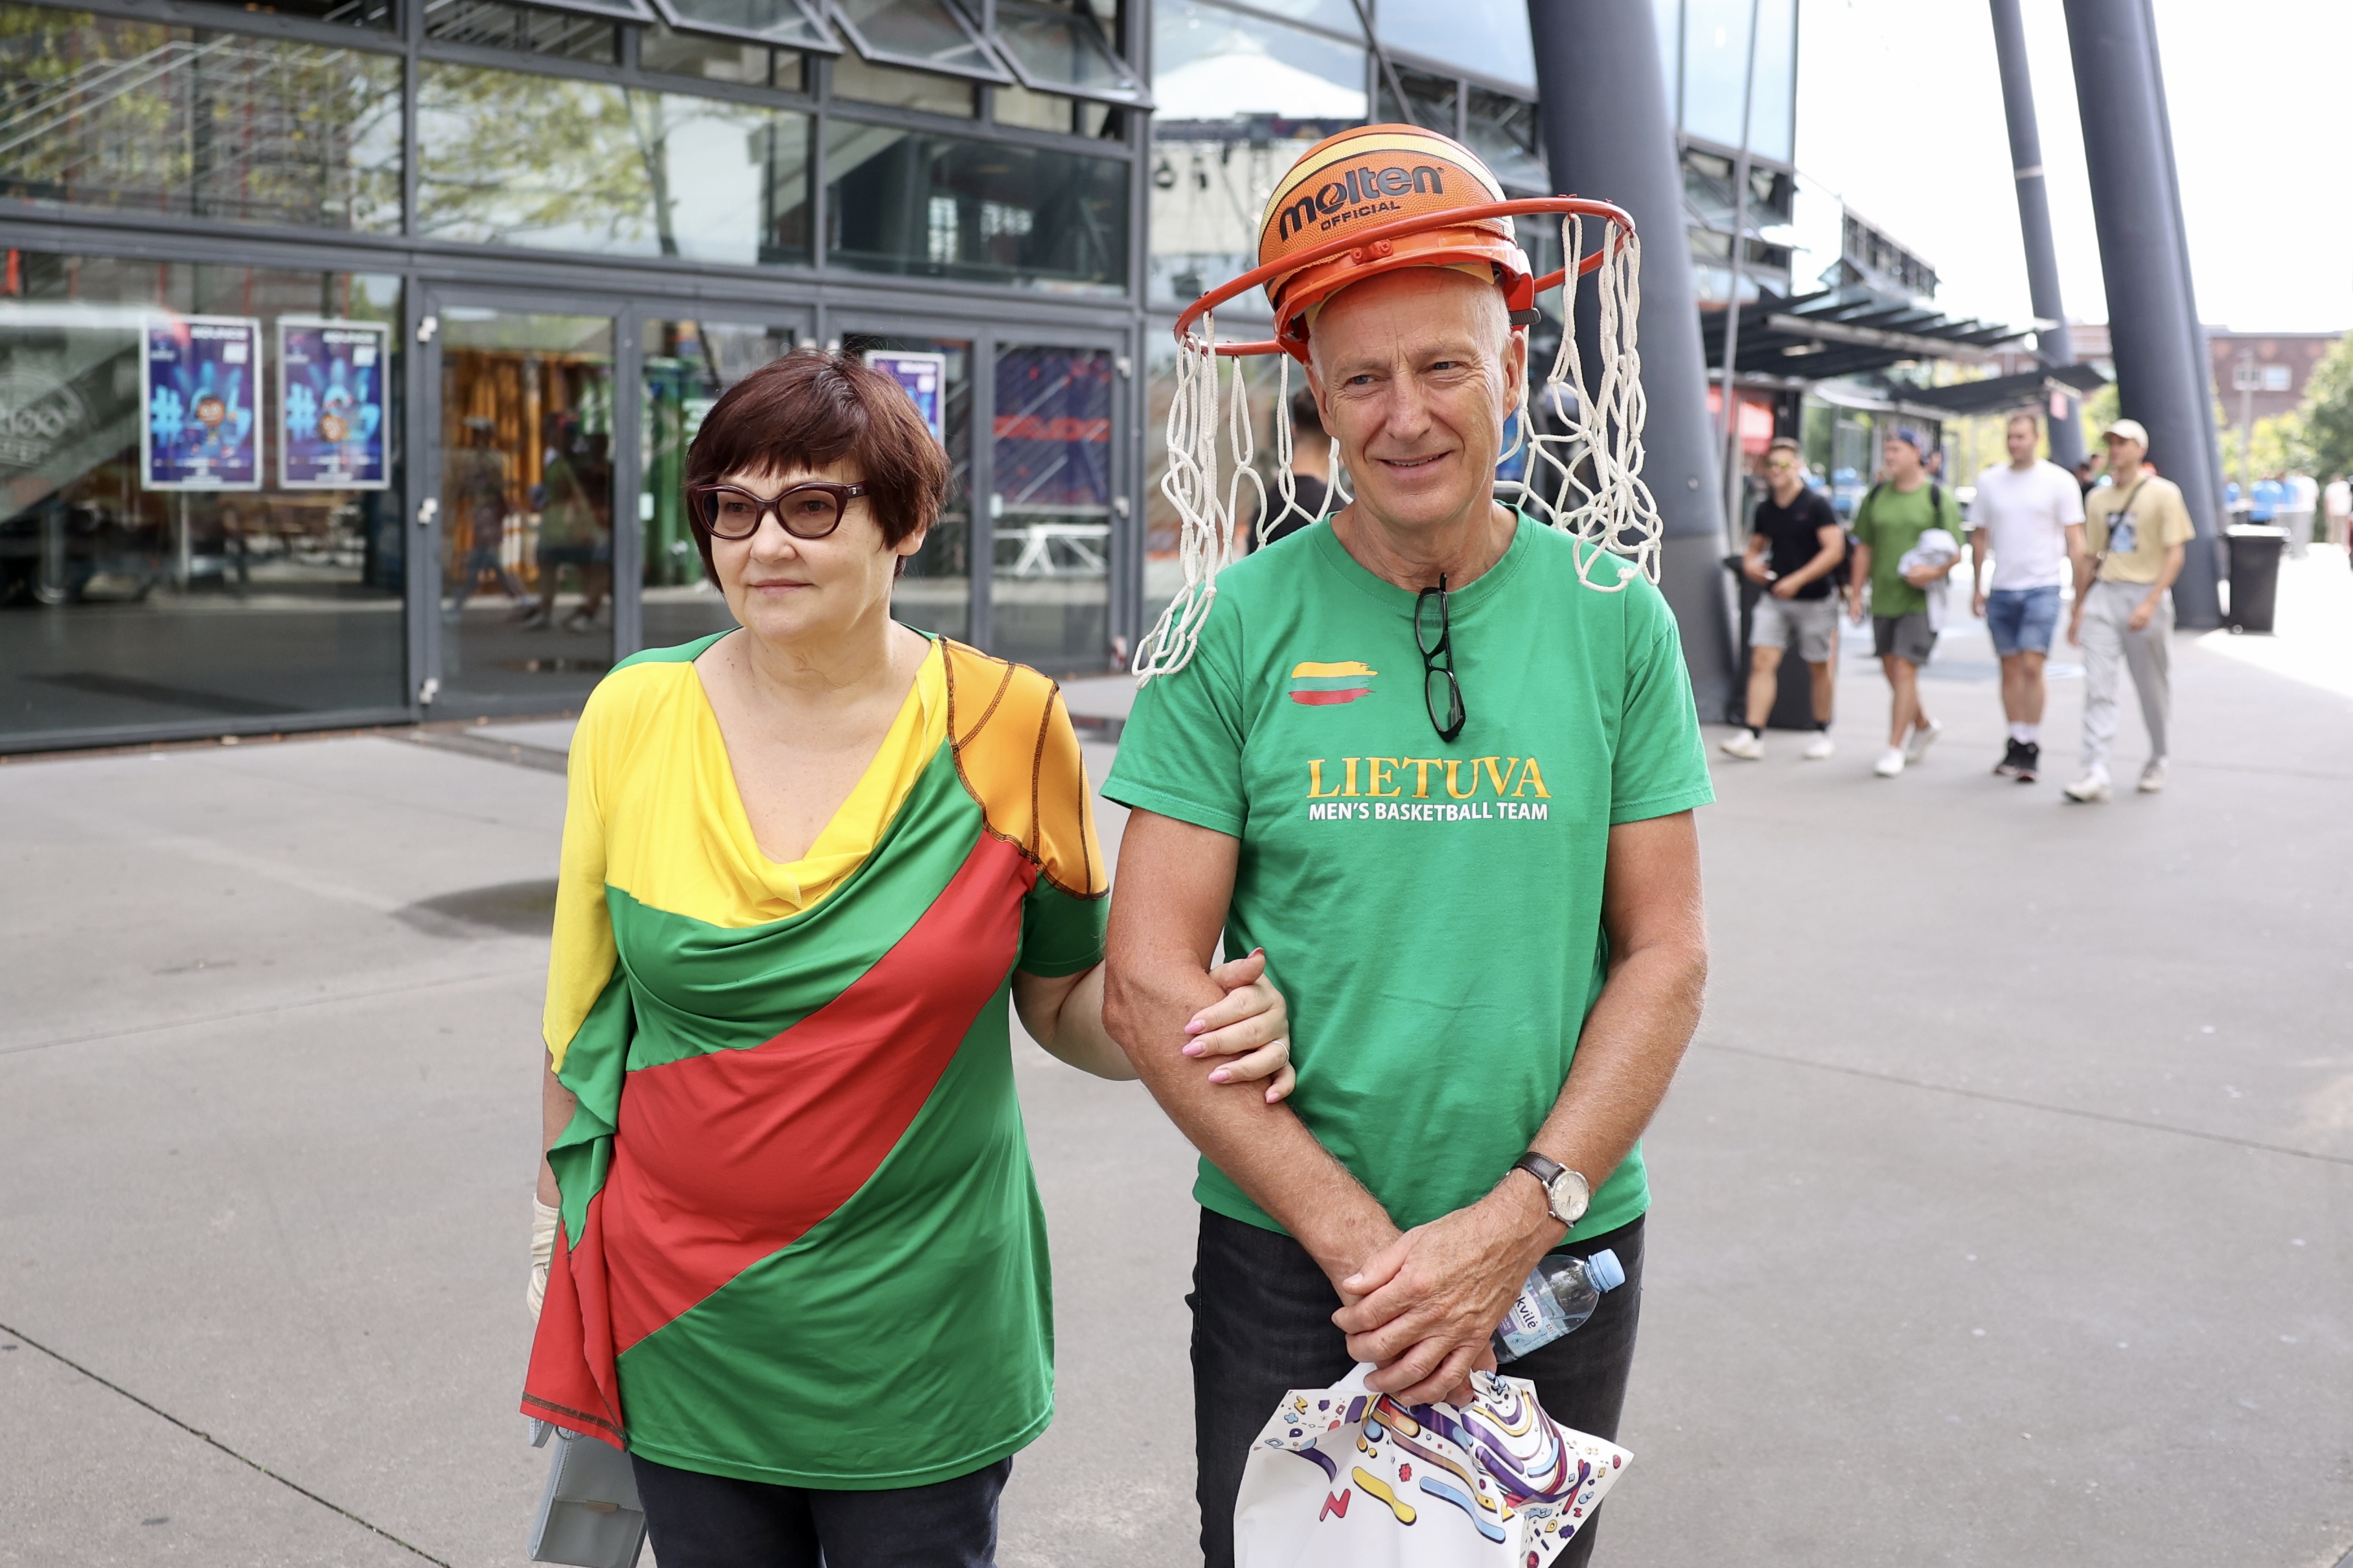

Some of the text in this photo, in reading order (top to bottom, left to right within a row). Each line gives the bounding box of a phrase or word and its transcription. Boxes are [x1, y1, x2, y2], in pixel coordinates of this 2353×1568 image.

[1321, 201, 1401, 231] OFFICIAL
[1307, 756, 1552, 799] LIETUVA
[1309, 802, 1548, 821] MEN'S BASKETBALL TEAM
[1515, 1293, 1539, 1329] kvilė
